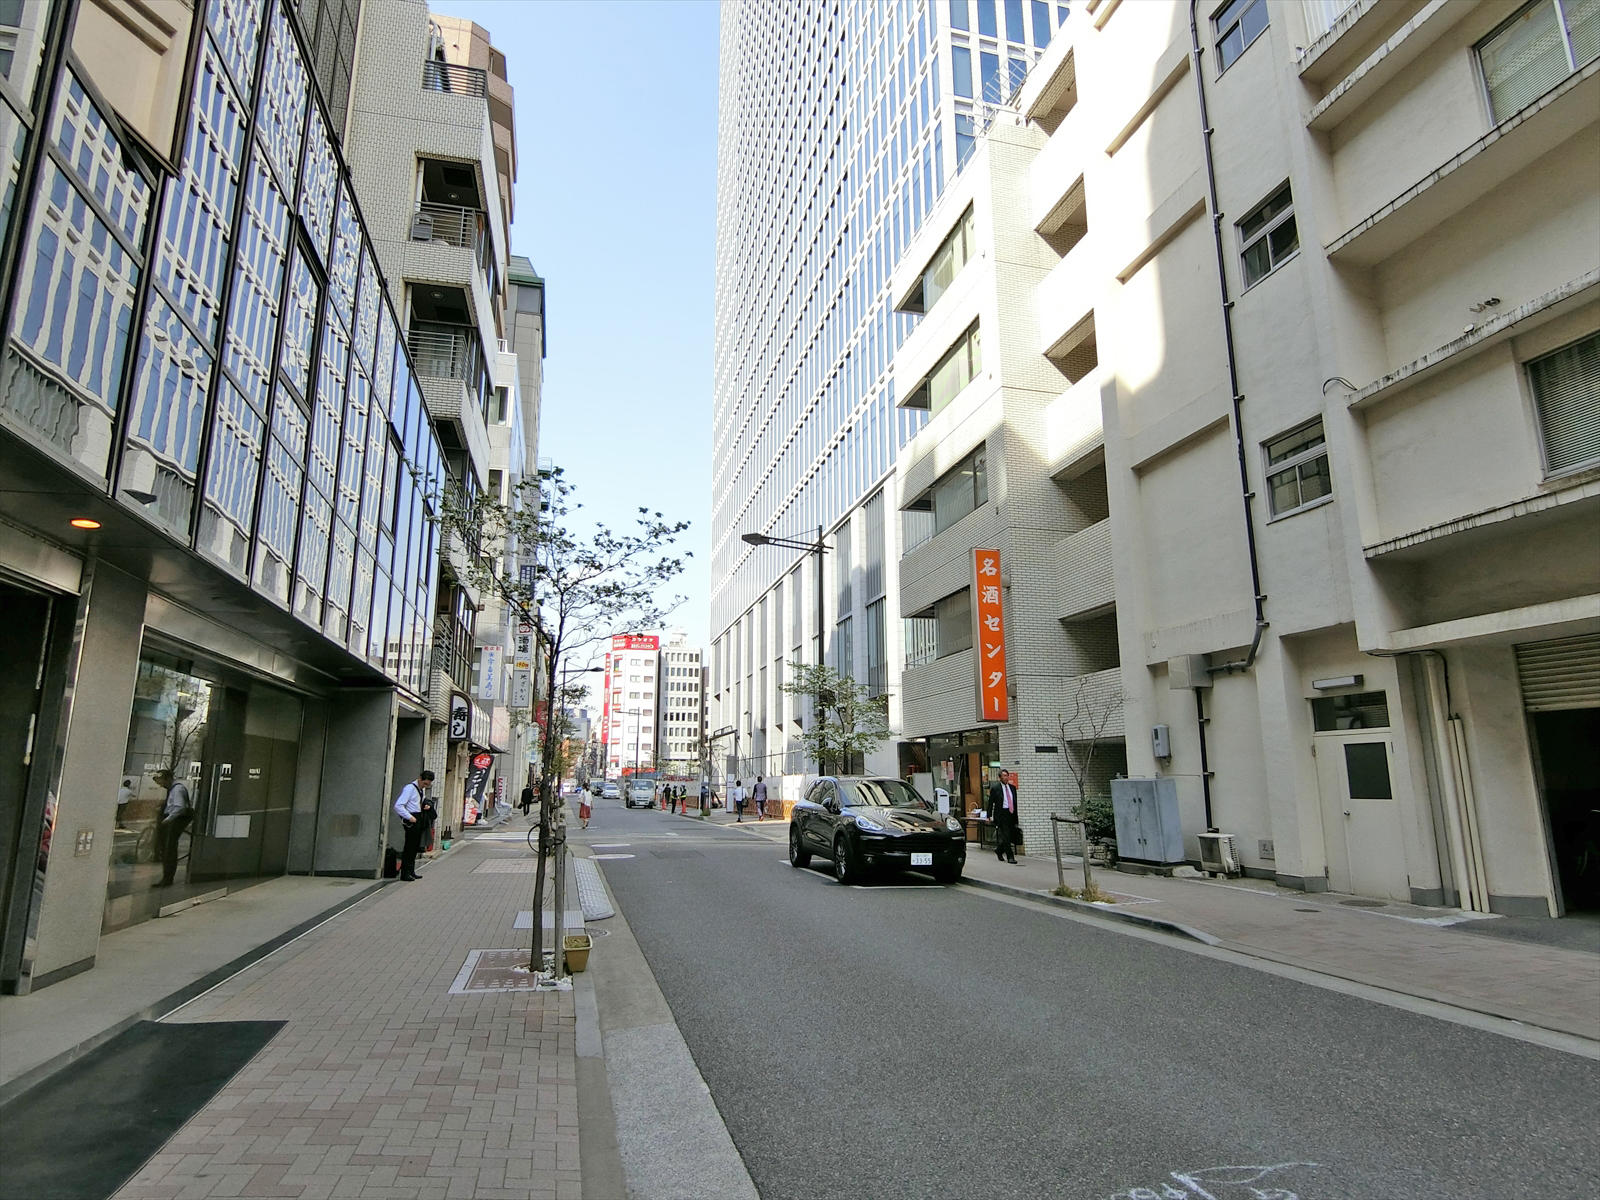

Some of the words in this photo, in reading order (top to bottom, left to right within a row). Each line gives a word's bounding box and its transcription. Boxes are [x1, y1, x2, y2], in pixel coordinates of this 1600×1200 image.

[979, 557, 1003, 712] 名酒センター
[452, 706, 468, 737] 寿し
